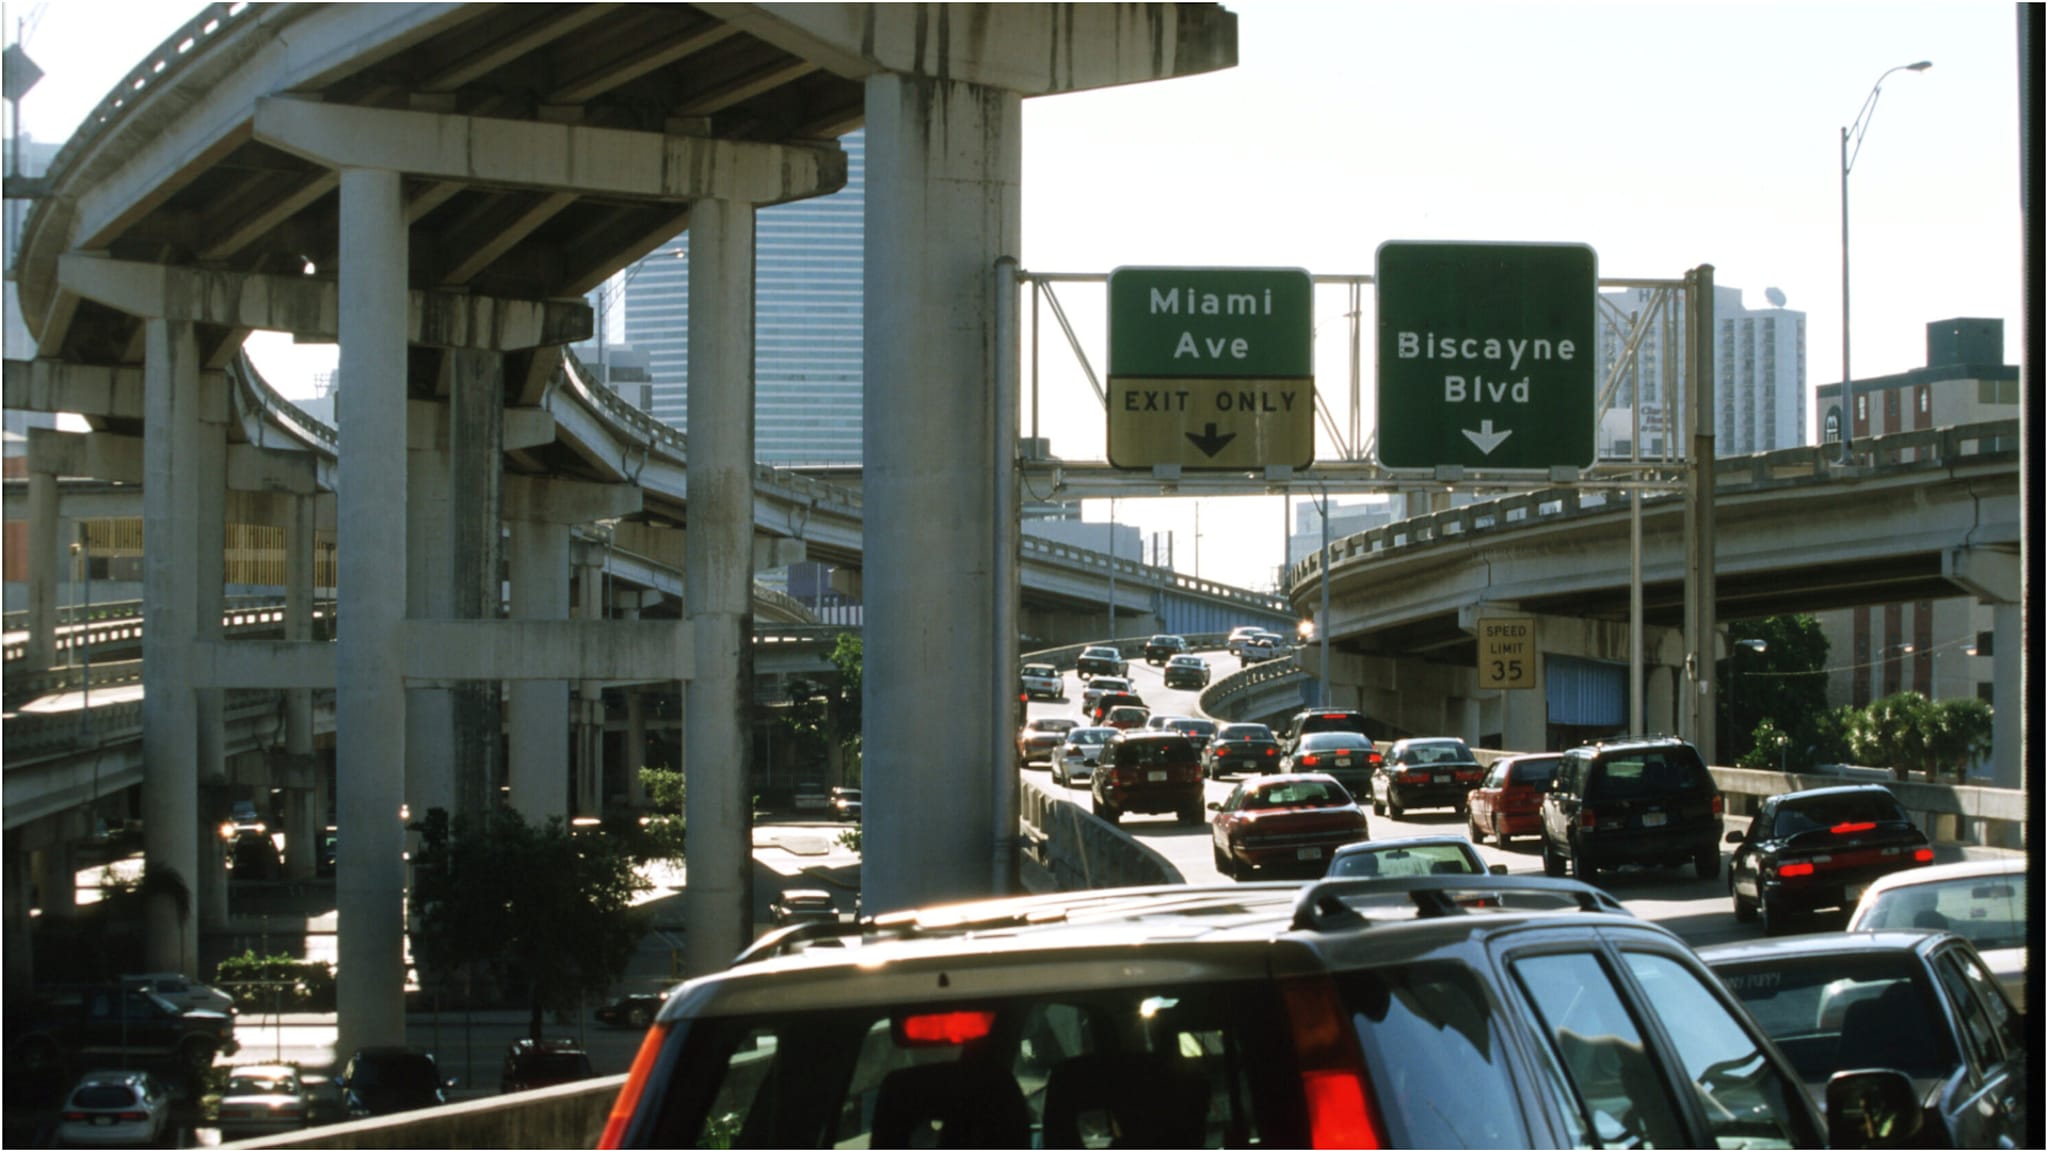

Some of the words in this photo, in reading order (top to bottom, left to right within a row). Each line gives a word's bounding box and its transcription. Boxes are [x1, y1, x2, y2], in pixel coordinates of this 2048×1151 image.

[1150, 287, 1272, 315] Miami
[1173, 331, 1249, 359] Ave
[1398, 331, 1576, 371] Biscayne
[1445, 375, 1530, 403] Blvd
[1125, 391, 1189, 411] EXIT
[1215, 391, 1296, 412] ONLY
[1486, 625, 1527, 637] SPEED
[1490, 642, 1523, 655] LIMIT
[1491, 660, 1523, 681] 35
